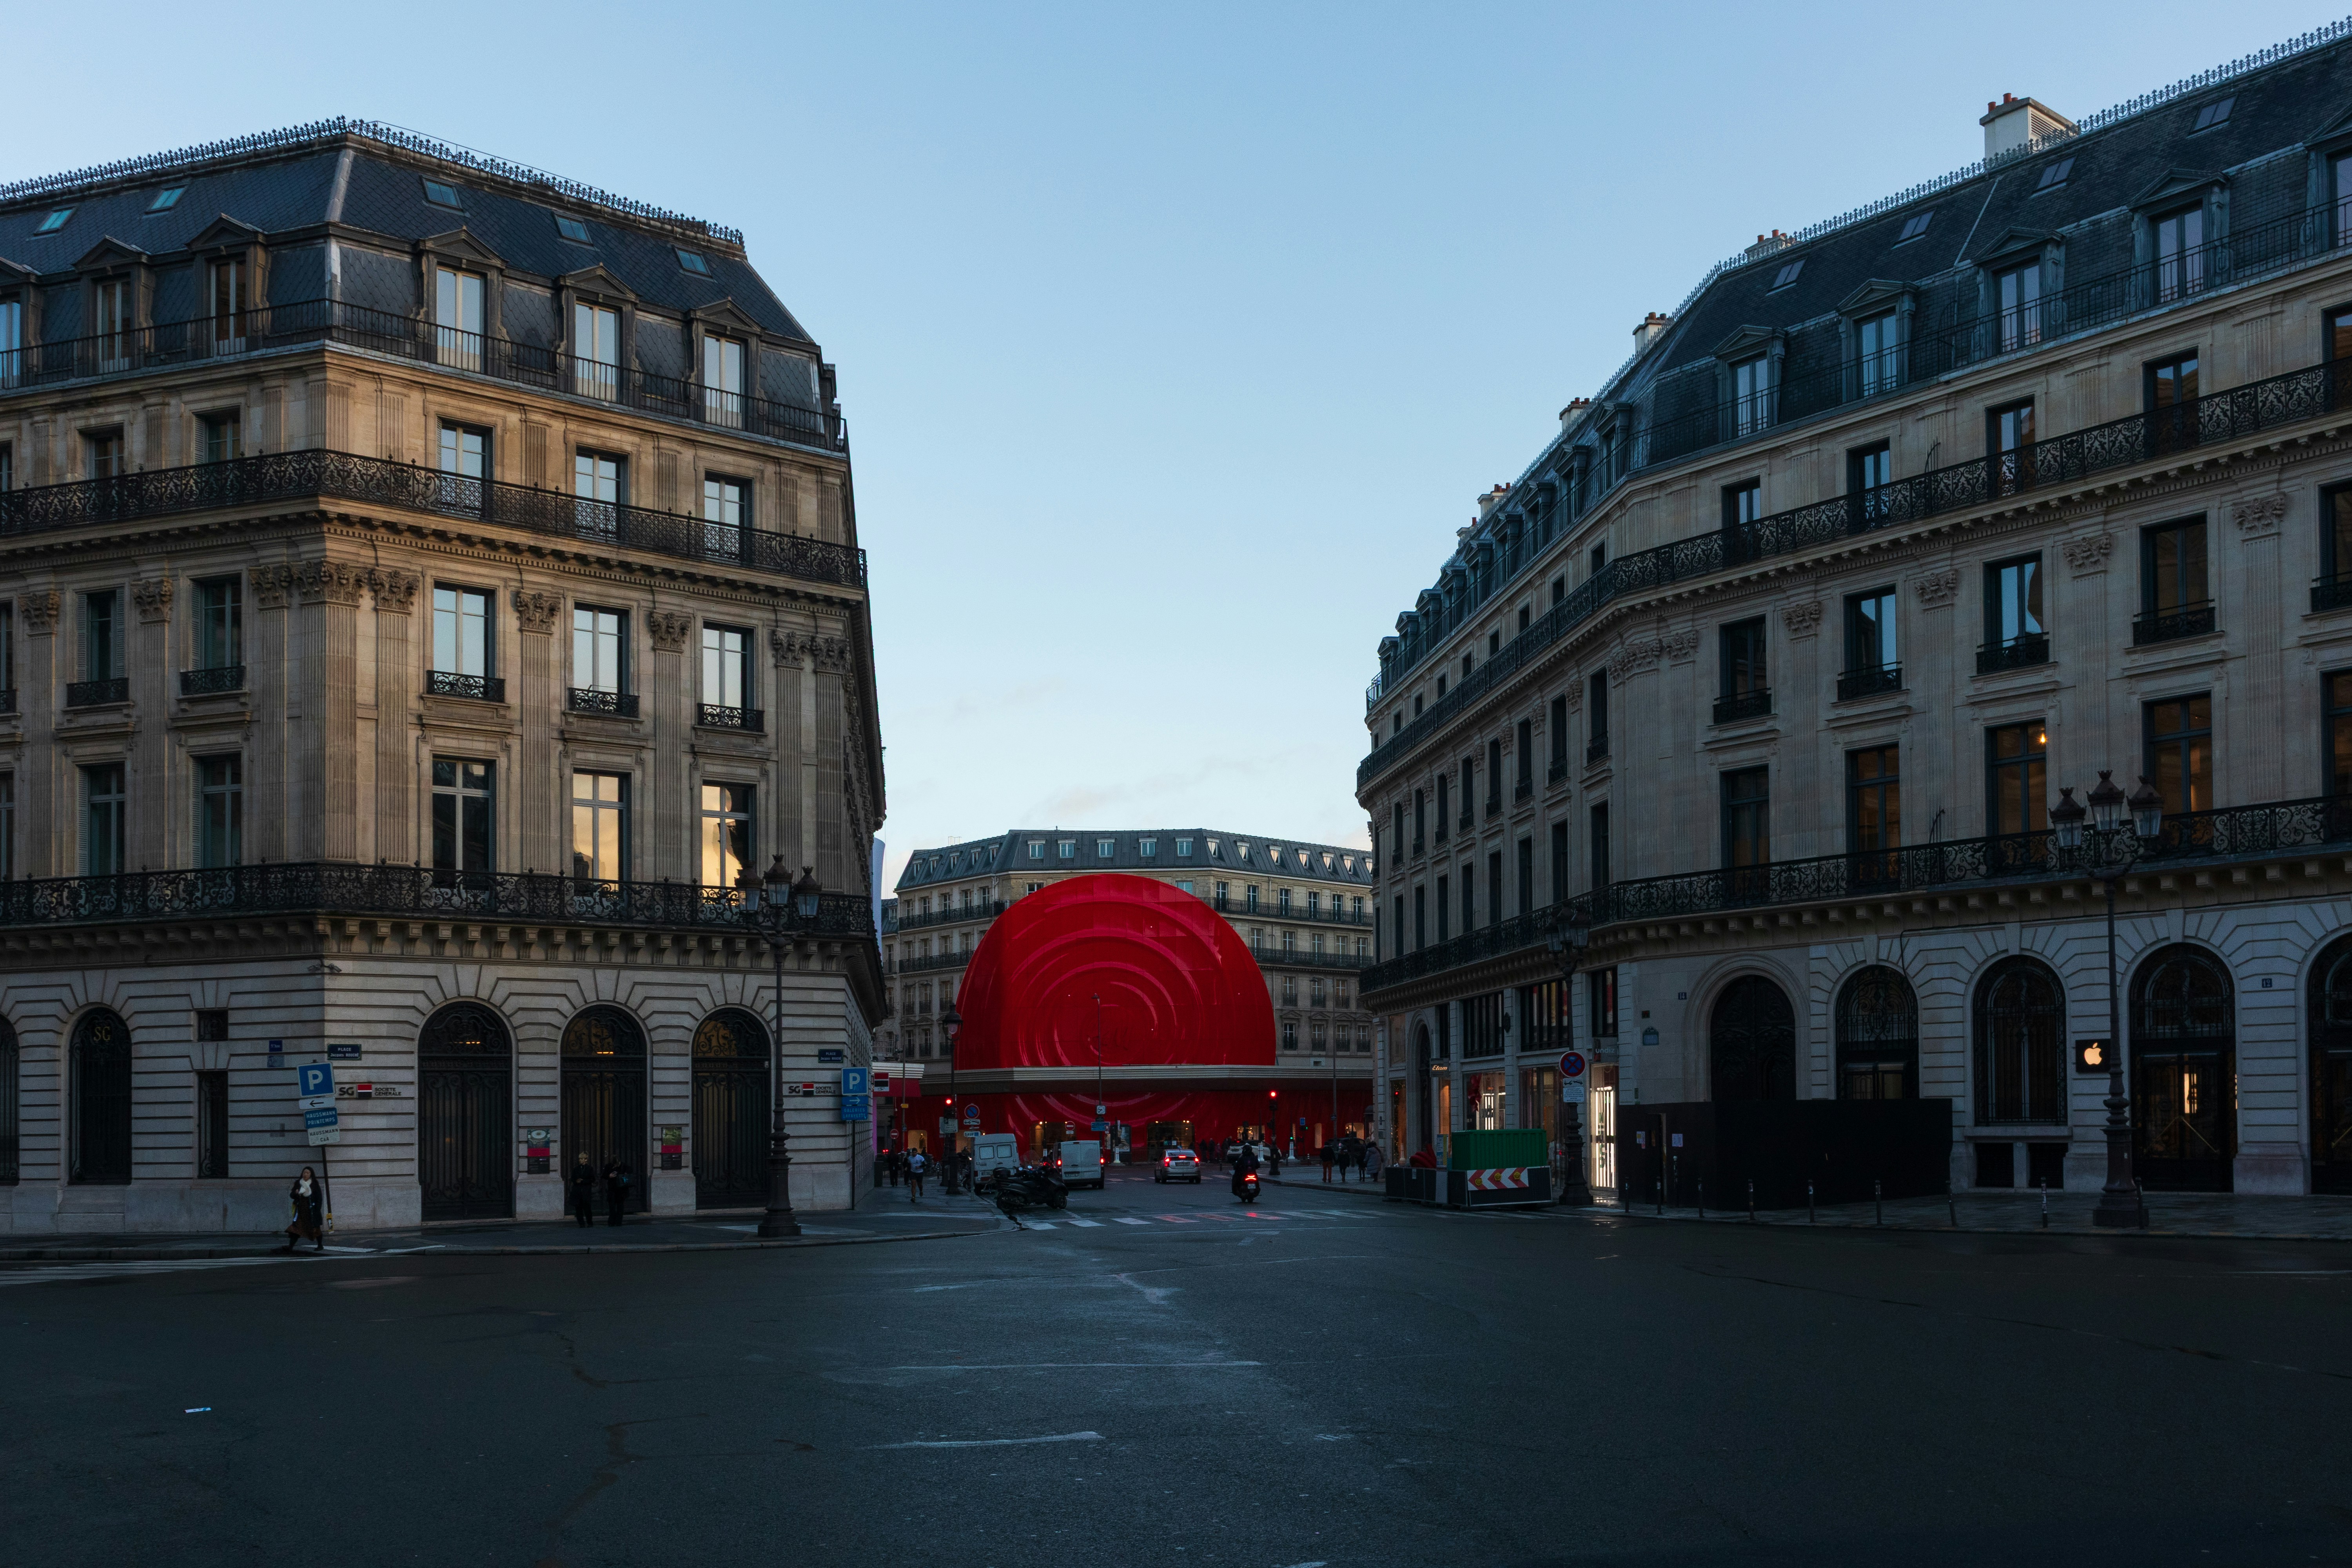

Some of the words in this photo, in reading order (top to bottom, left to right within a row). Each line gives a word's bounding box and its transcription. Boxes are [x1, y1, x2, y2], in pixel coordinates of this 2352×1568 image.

[93, 1026, 111, 1041] SG
[307, 1070, 323, 1090] P
[849, 1073, 860, 1090] P
[339, 1087, 354, 1096] SG
[788, 1085, 800, 1094] SG
[306, 1110, 336, 1118] HAUSSMANN
[308, 1117, 336, 1125] PRINTEMPS
[309, 1128, 339, 1136] HAUSSMANN
